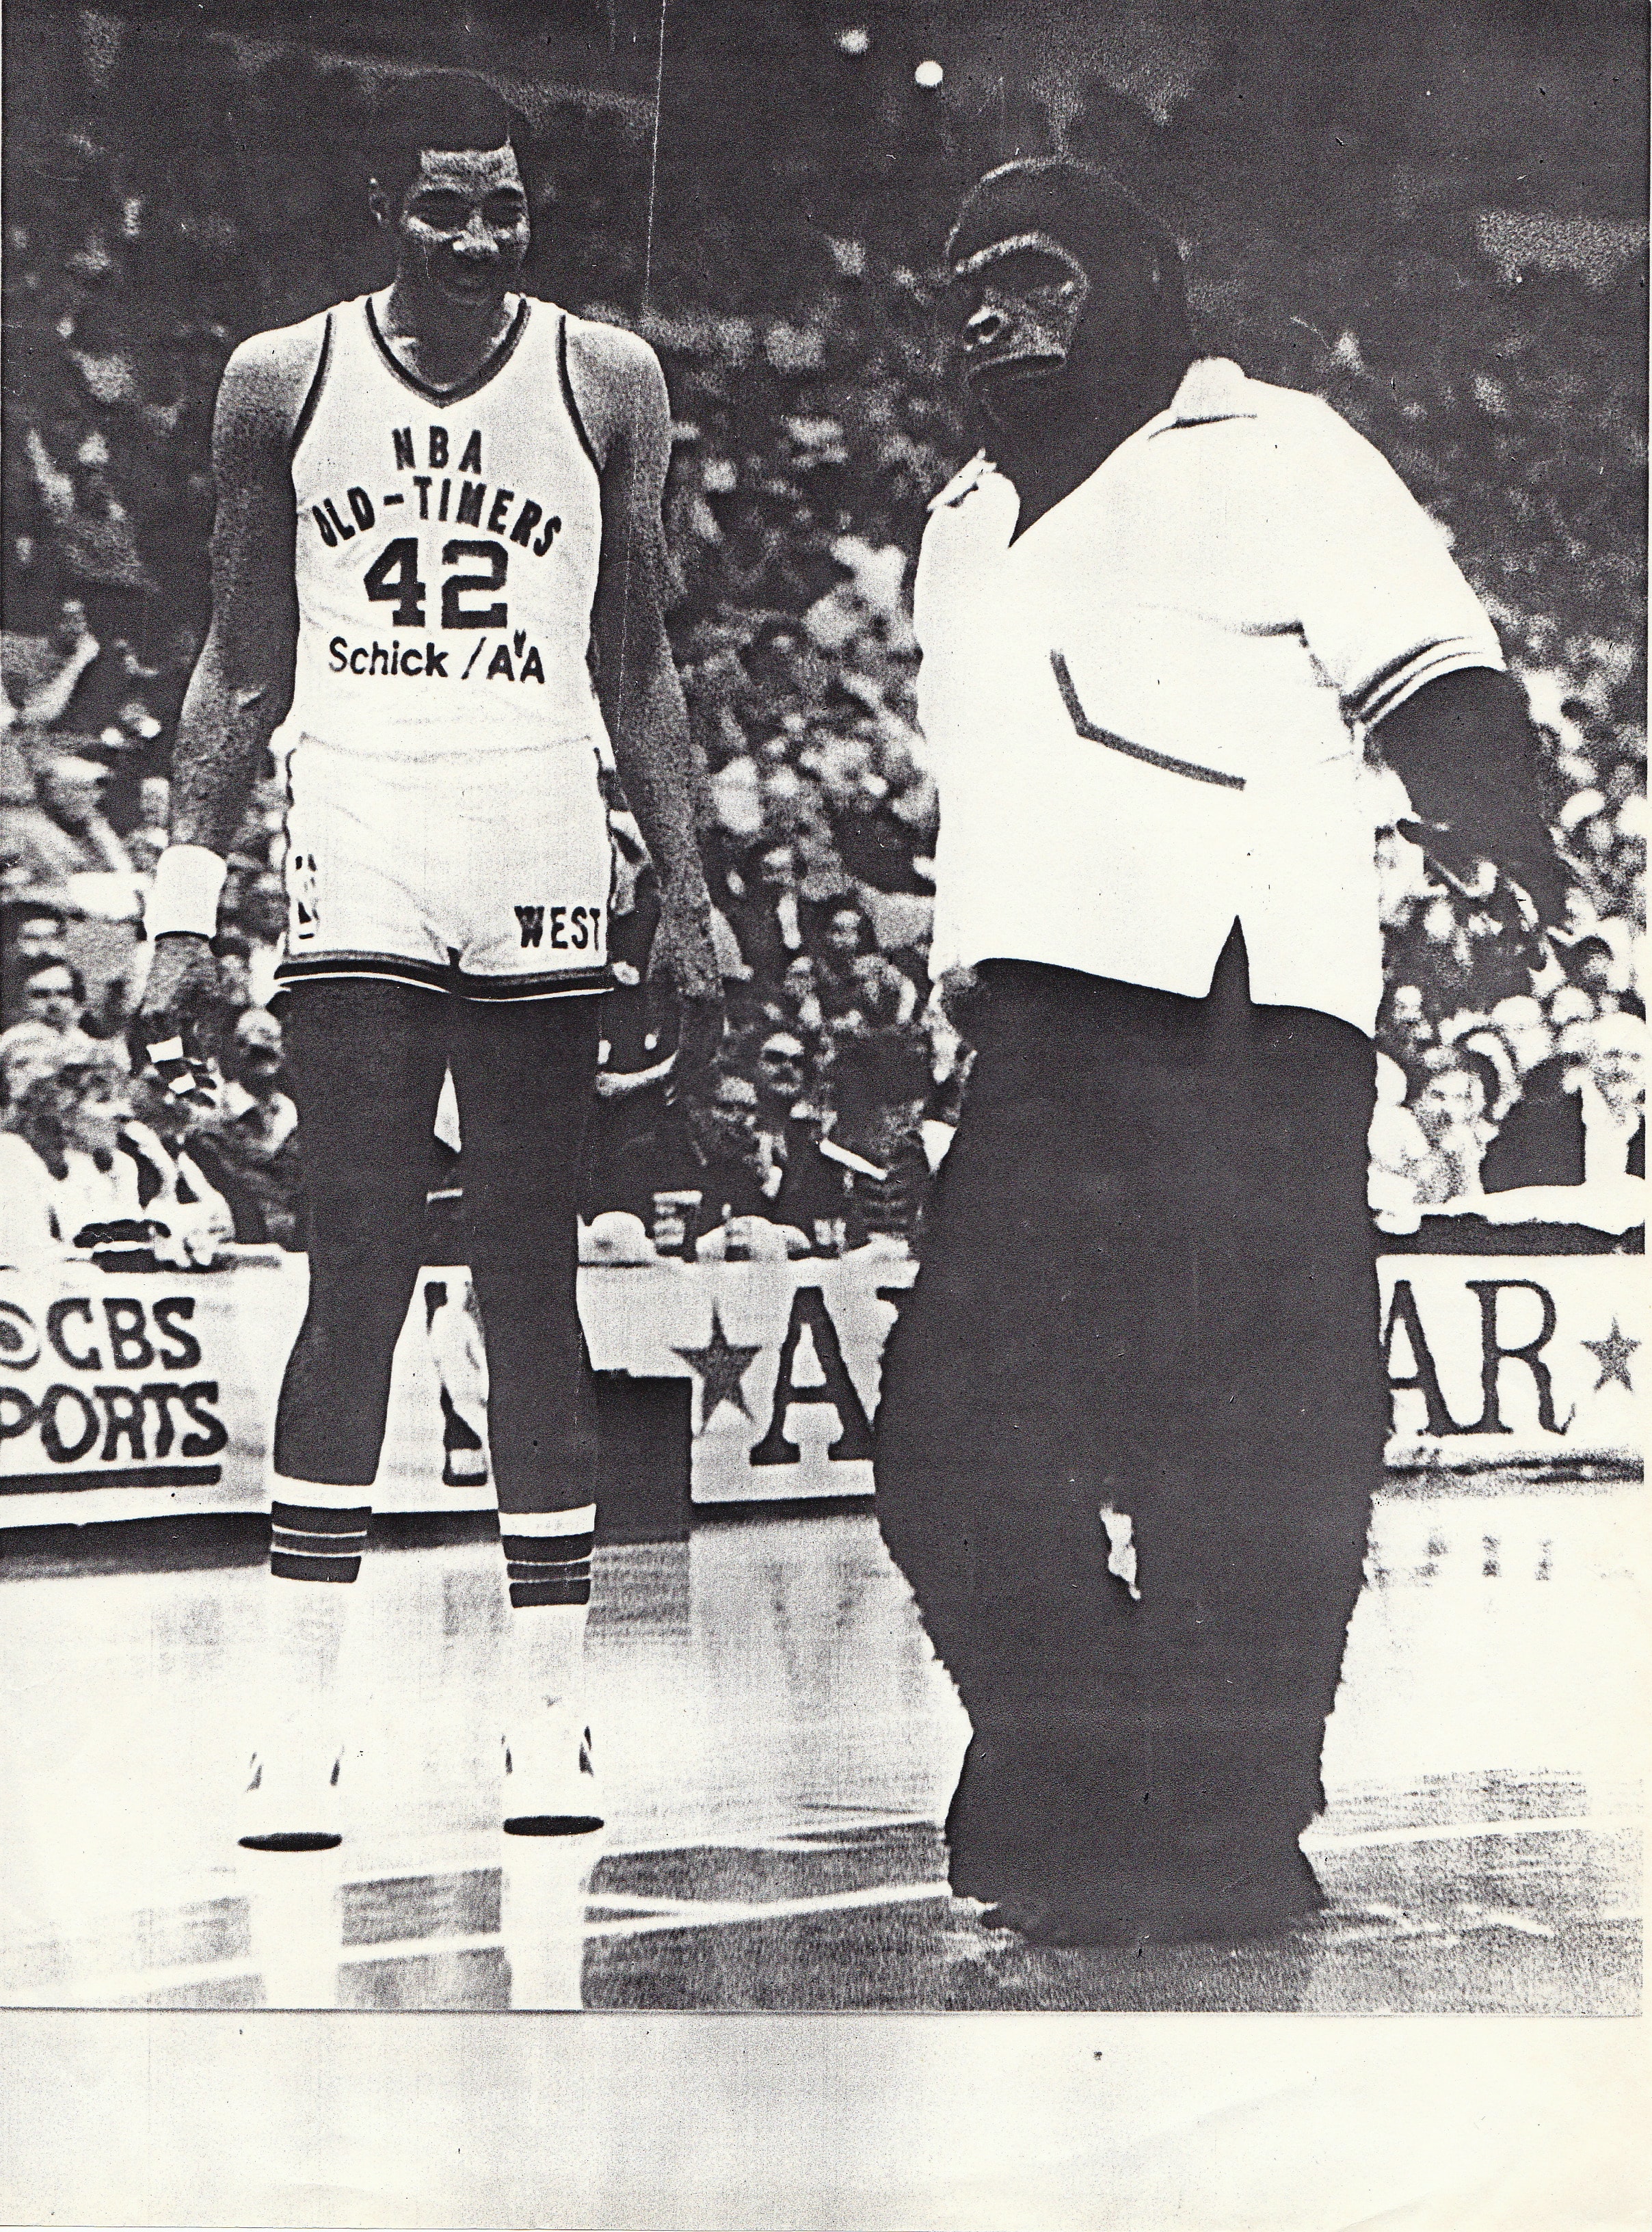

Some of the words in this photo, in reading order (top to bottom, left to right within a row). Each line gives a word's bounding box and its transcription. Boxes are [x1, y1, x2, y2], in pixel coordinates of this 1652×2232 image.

[392, 425, 482, 475] NBA
[363, 537, 509, 630] 42
[328, 636, 449, 678] Schick
[514, 905, 601, 952] WEST
[46, 1297, 201, 1370] CBS
